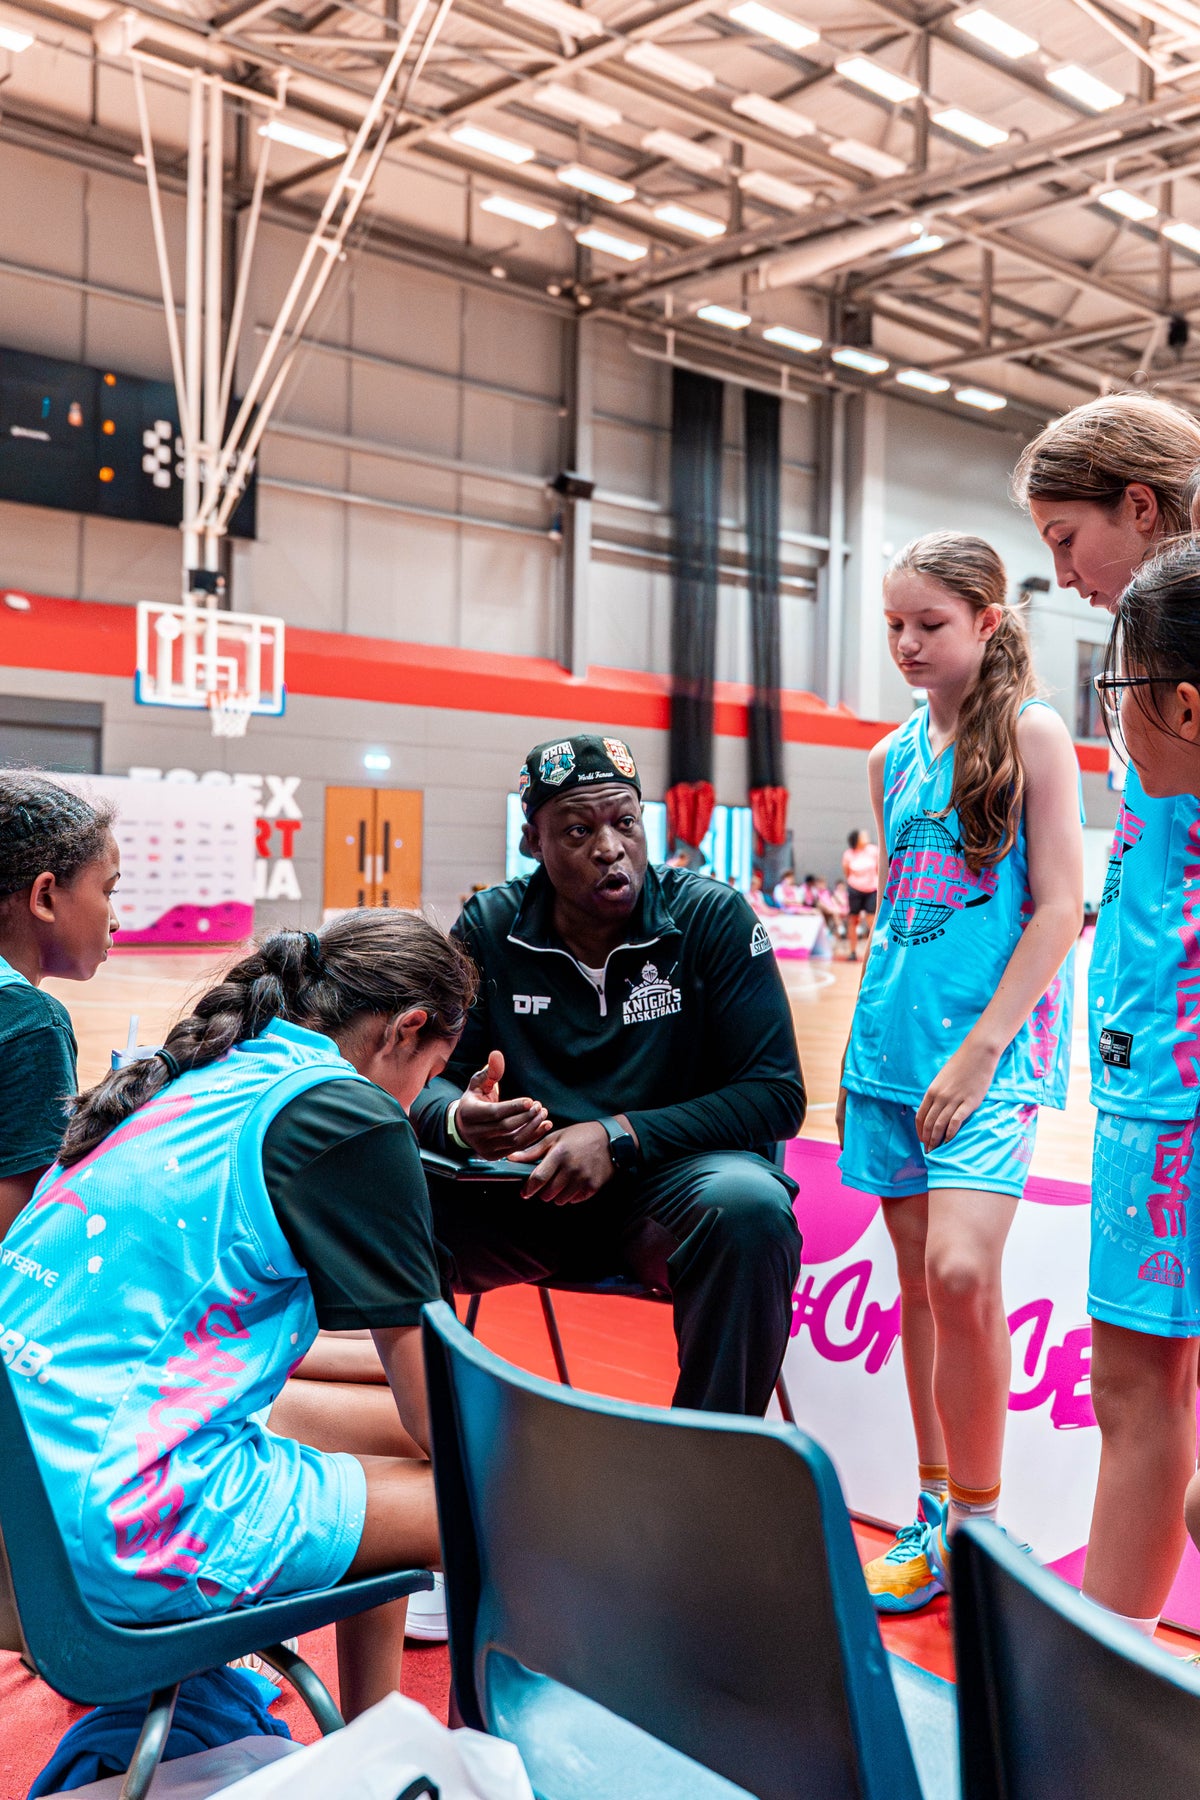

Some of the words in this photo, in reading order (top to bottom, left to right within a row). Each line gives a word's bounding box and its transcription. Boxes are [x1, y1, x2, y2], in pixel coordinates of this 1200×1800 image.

[912, 928, 946, 946] 2023
[512, 994, 552, 1015] DF
[622, 988, 682, 1015] KNIGHTS
[622, 1002, 682, 1025] BASKETBALL
[0, 1247, 60, 1289] RTSERVE
